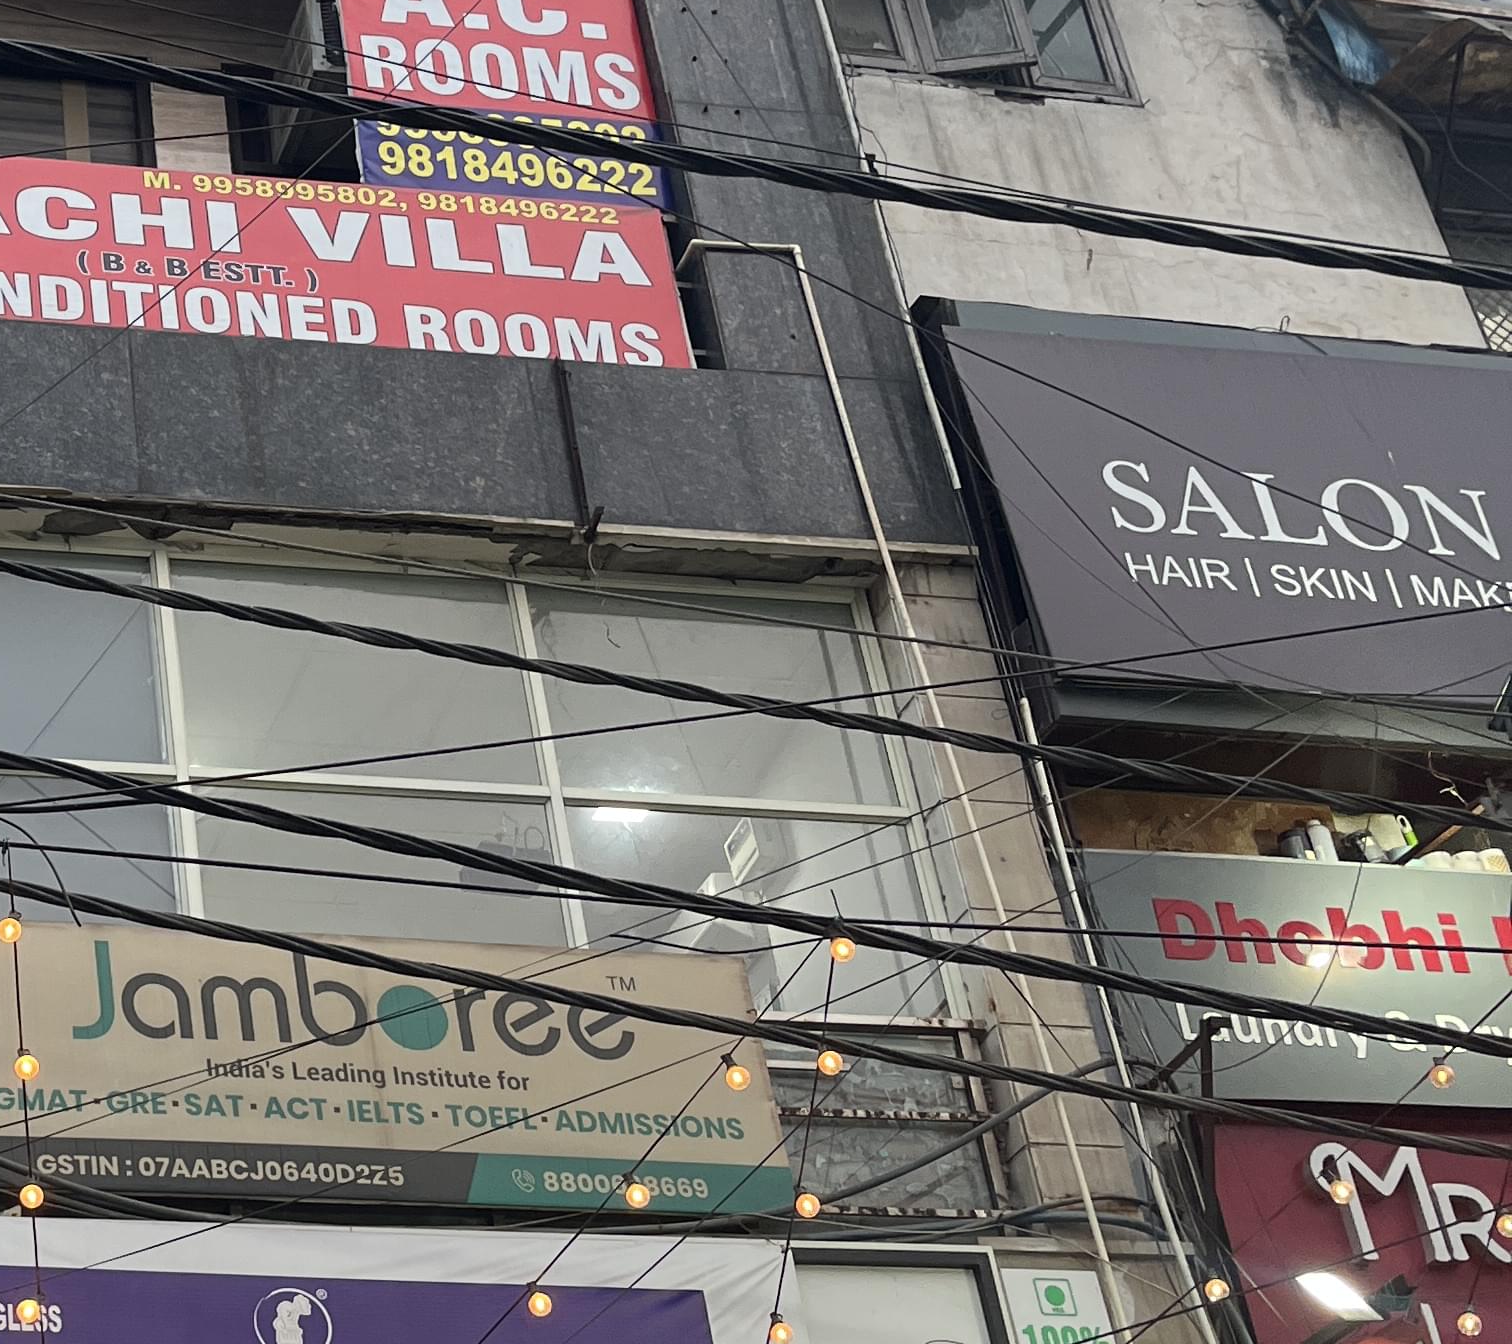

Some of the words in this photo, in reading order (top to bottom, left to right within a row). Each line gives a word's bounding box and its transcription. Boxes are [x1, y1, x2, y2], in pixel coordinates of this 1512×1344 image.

[359, 34, 642, 111] ROOMS
[378, 141, 657, 196] 9818496222
[143, 171, 181, 191] M.
[418, 193, 620, 225] 9818496222
[287, 206, 652, 287] VILLA
[403, 303, 664, 368] ROOMS
[1101, 459, 1501, 561] SALON
[1124, 552, 1237, 592] HAIR
[1269, 564, 1377, 602] SKIN
[72, 939, 635, 1060] Jamboree
[206, 1058, 285, 1080] India's
[292, 1061, 386, 1088] Leading
[393, 1065, 491, 1091] Institute
[496, 1070, 529, 1092] for
[106, 1090, 167, 1115] GRE
[184, 1093, 244, 1117] SAT
[264, 1095, 327, 1120] ACT
[347, 1098, 424, 1126] IELTS
[445, 1104, 538, 1130] TOEFL
[554, 1109, 745, 1141] ADMISSIONS
[35, 1154, 119, 1177] GSTIN
